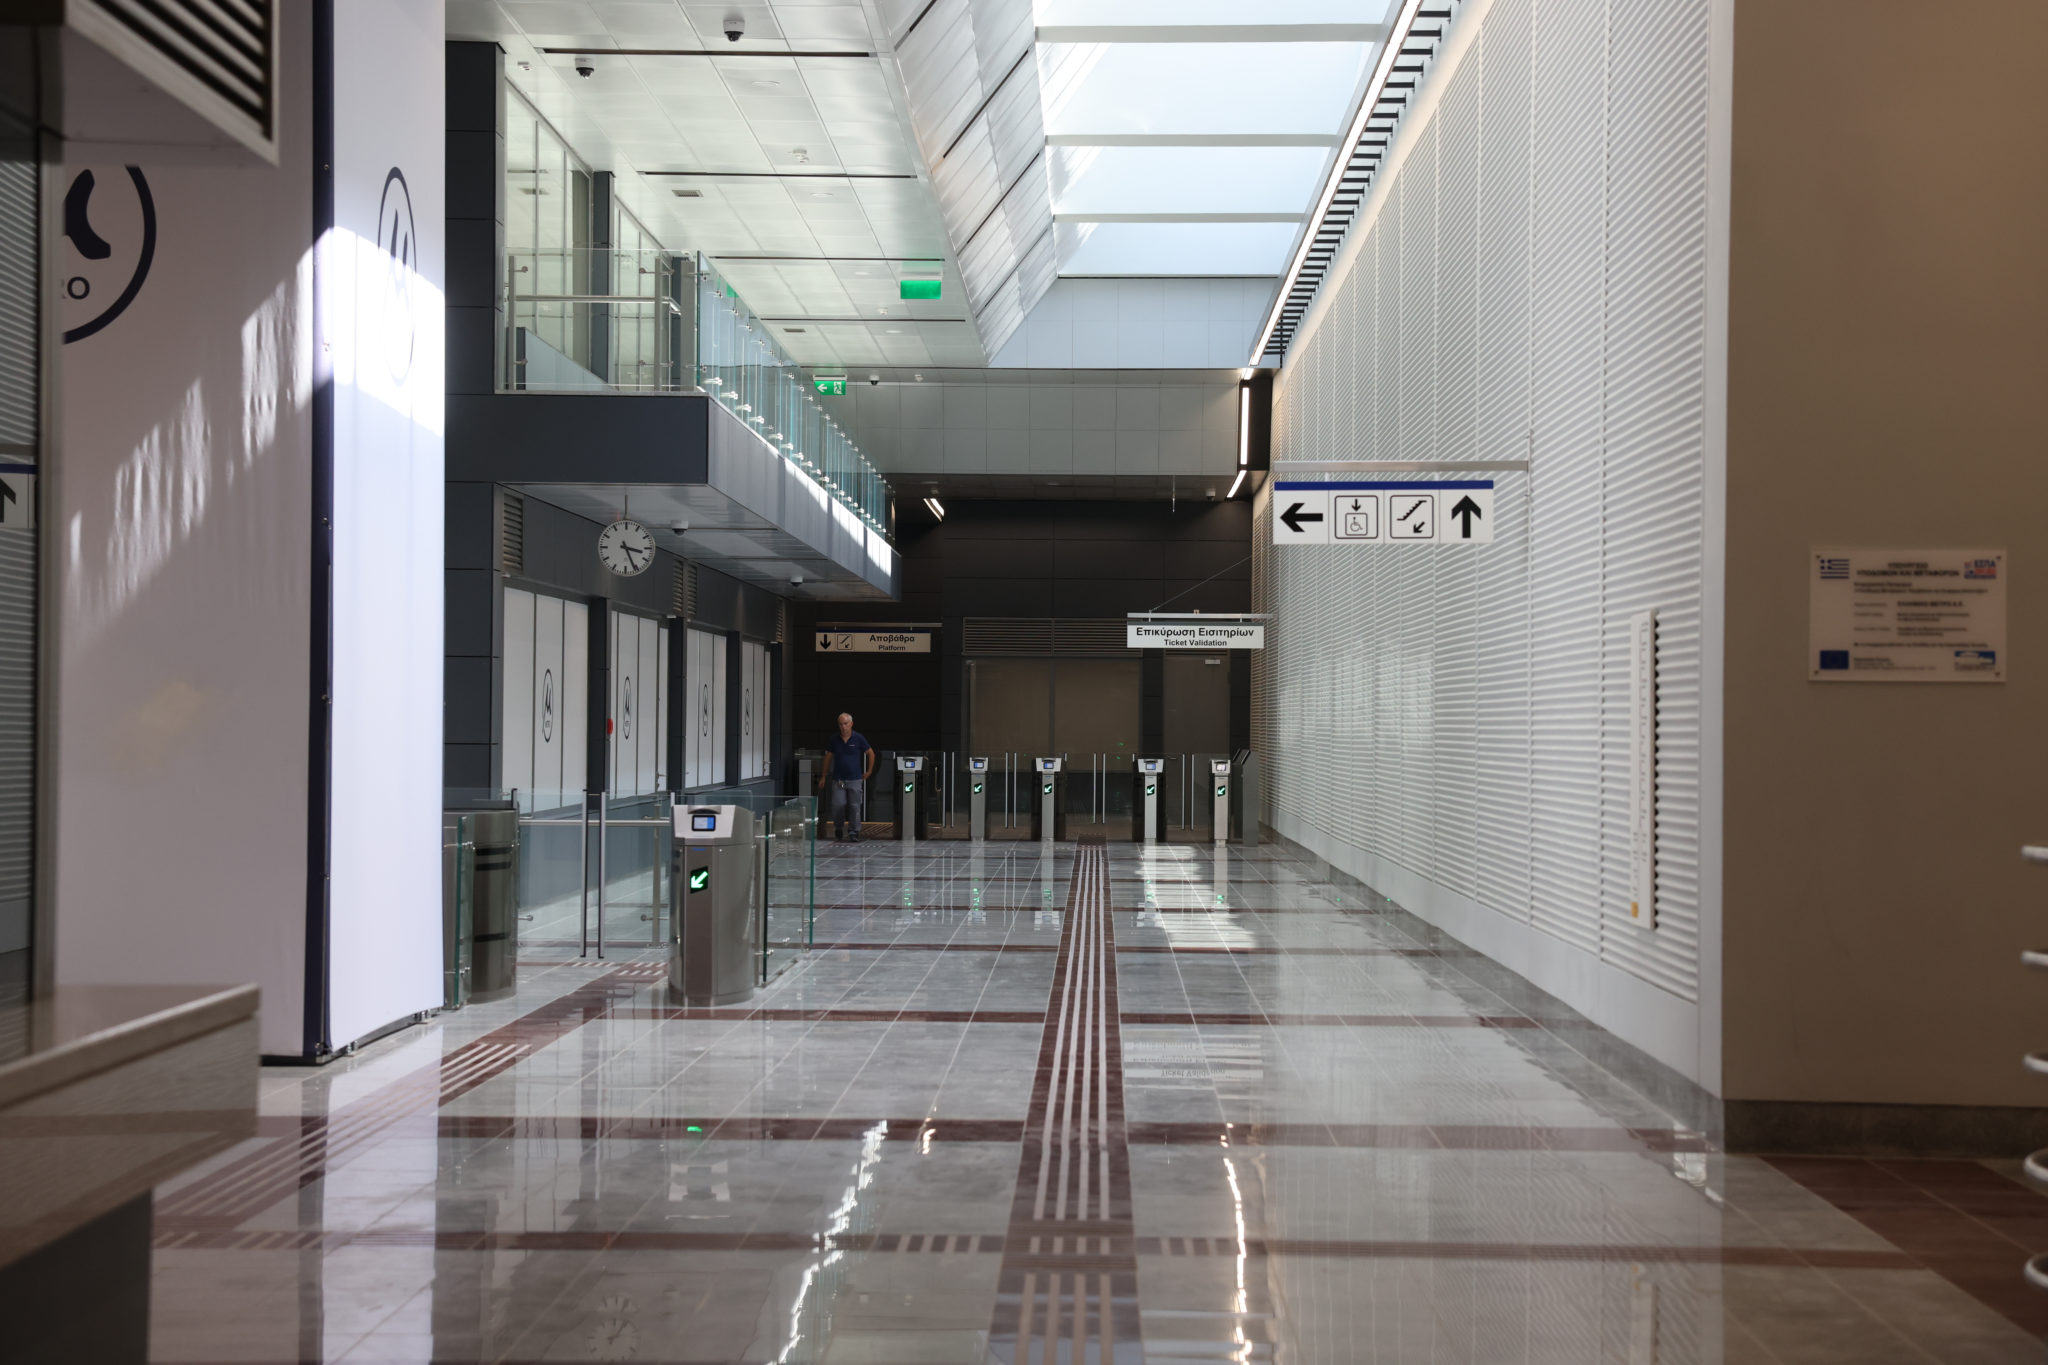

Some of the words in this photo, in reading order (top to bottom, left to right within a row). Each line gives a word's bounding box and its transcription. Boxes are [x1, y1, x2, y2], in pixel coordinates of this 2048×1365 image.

[1136, 627, 1195, 638] Επικύρωση
[1198, 627, 1255, 638] Εισιτηρίων
[869, 634, 915, 643] Αποβάθρα
[1164, 639, 1187, 647] Ticket
[1189, 639, 1228, 647] Validation
